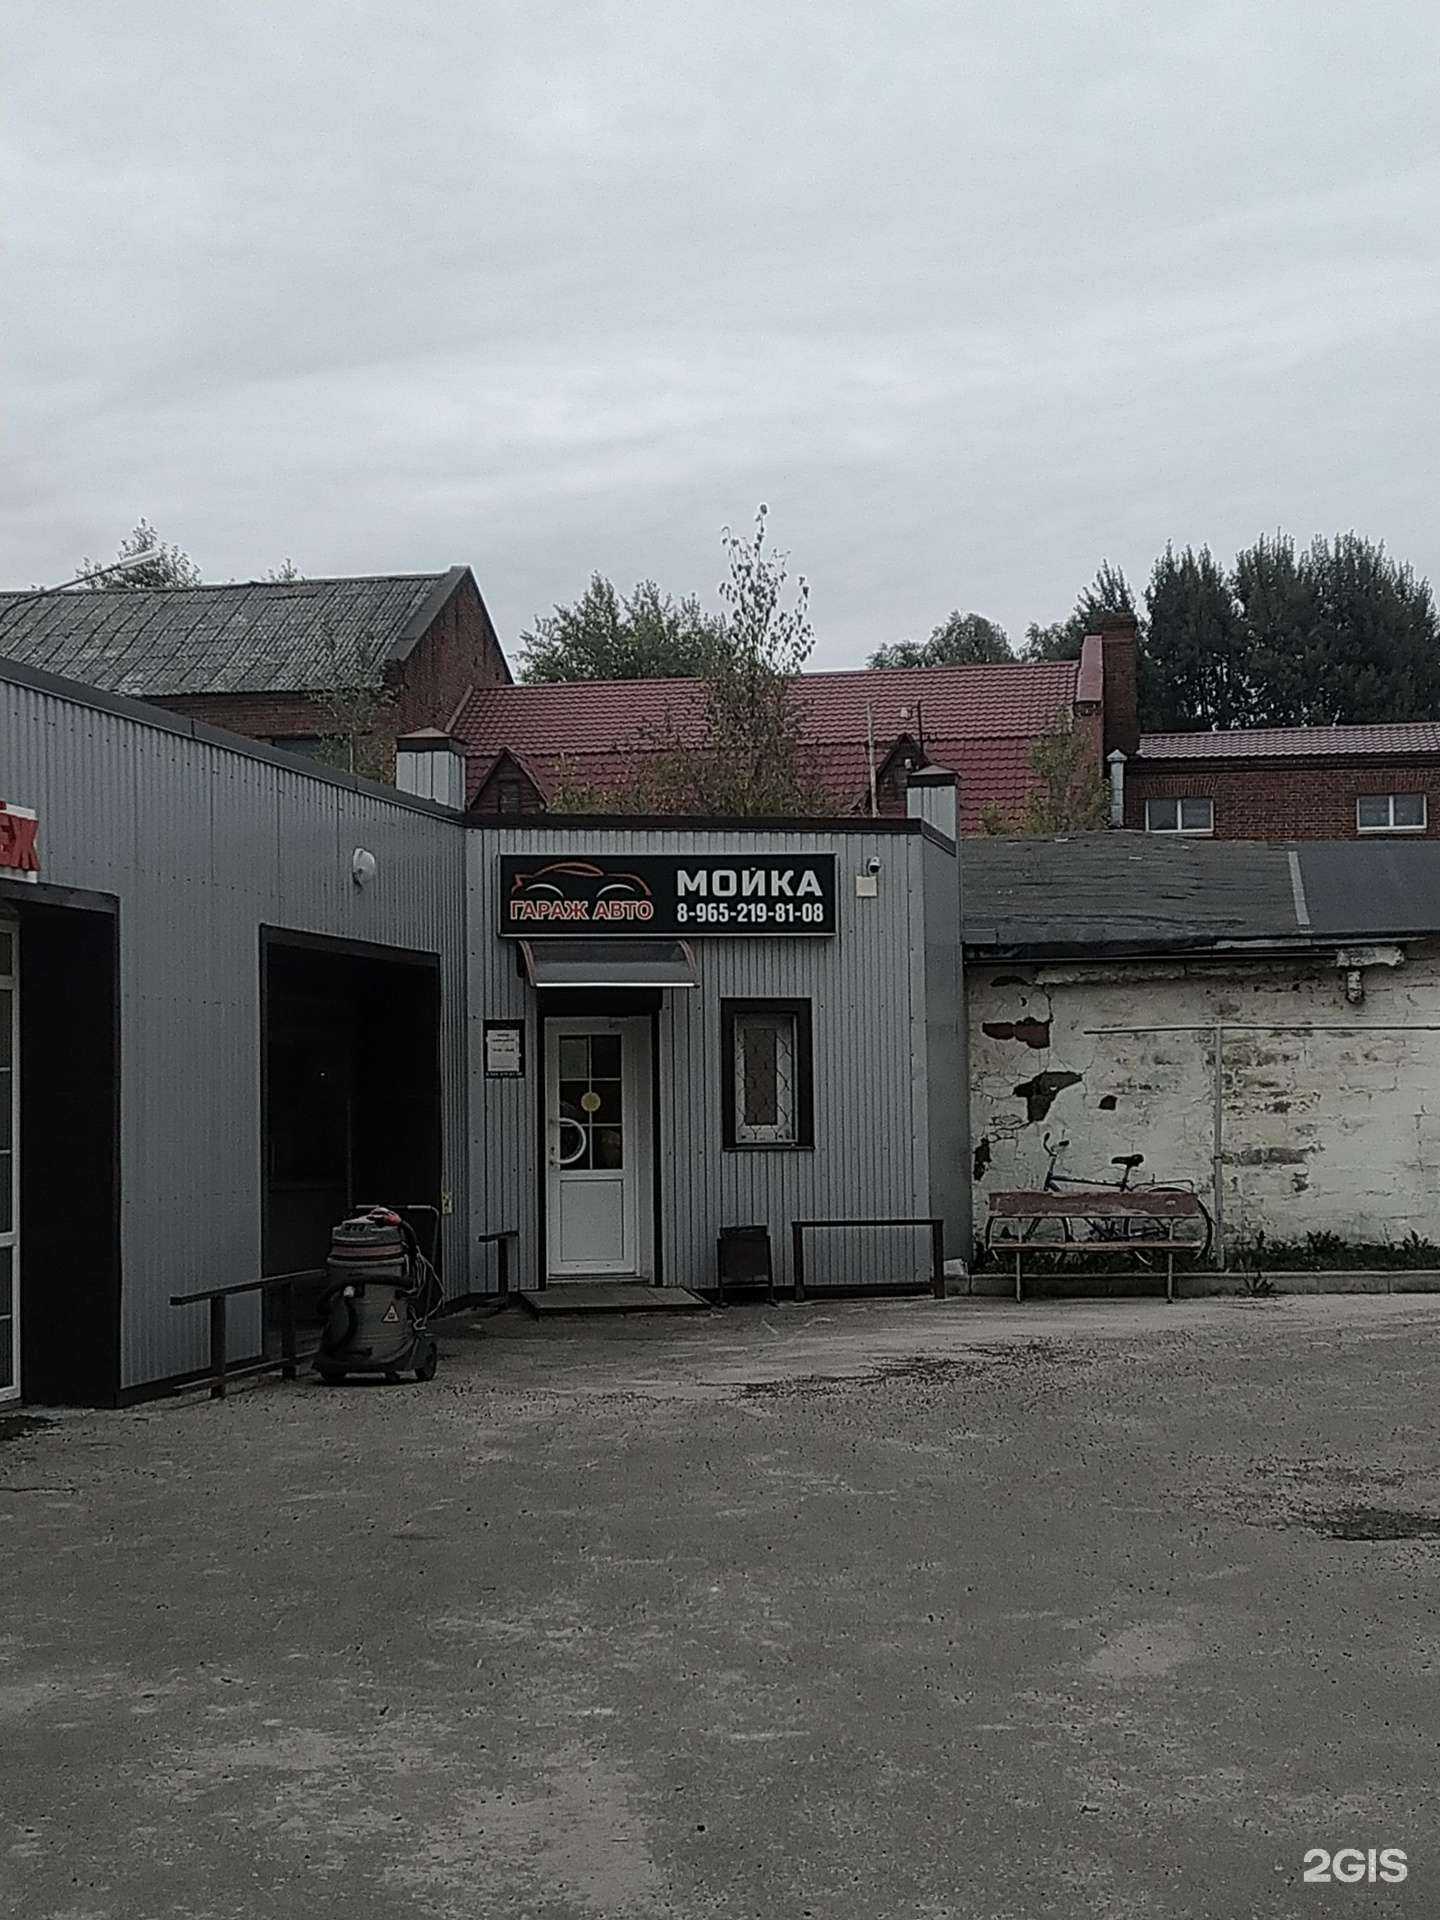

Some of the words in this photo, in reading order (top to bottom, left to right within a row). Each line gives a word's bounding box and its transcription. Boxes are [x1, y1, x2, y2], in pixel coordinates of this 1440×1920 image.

[677, 867, 823, 896] МОЙКА
[510, 900, 589, 920] ГАРАЖ
[592, 900, 654, 920] АВТО
[677, 903, 824, 922] 8-965-219-81-08
